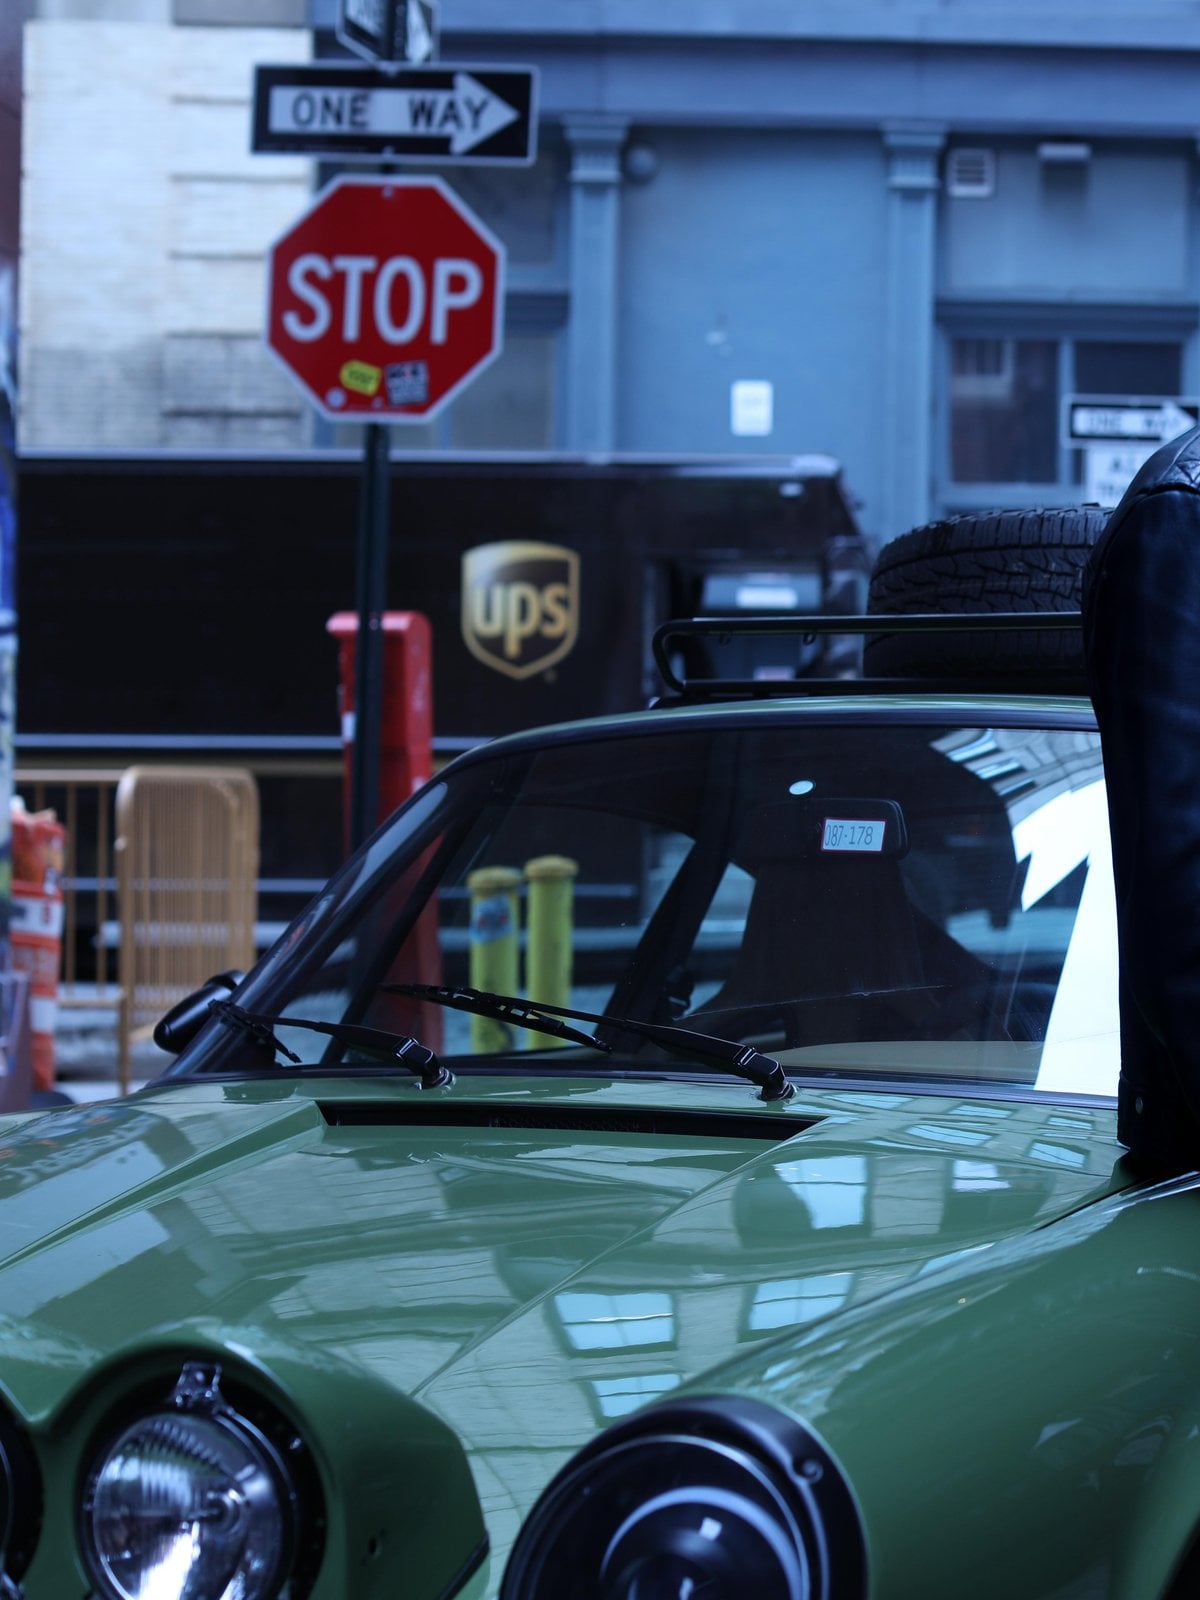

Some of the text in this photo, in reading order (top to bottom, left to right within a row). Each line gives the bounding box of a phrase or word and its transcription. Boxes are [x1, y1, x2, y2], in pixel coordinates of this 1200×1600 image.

[292, 92, 489, 130] ONE WAY
[282, 253, 484, 345] STOP
